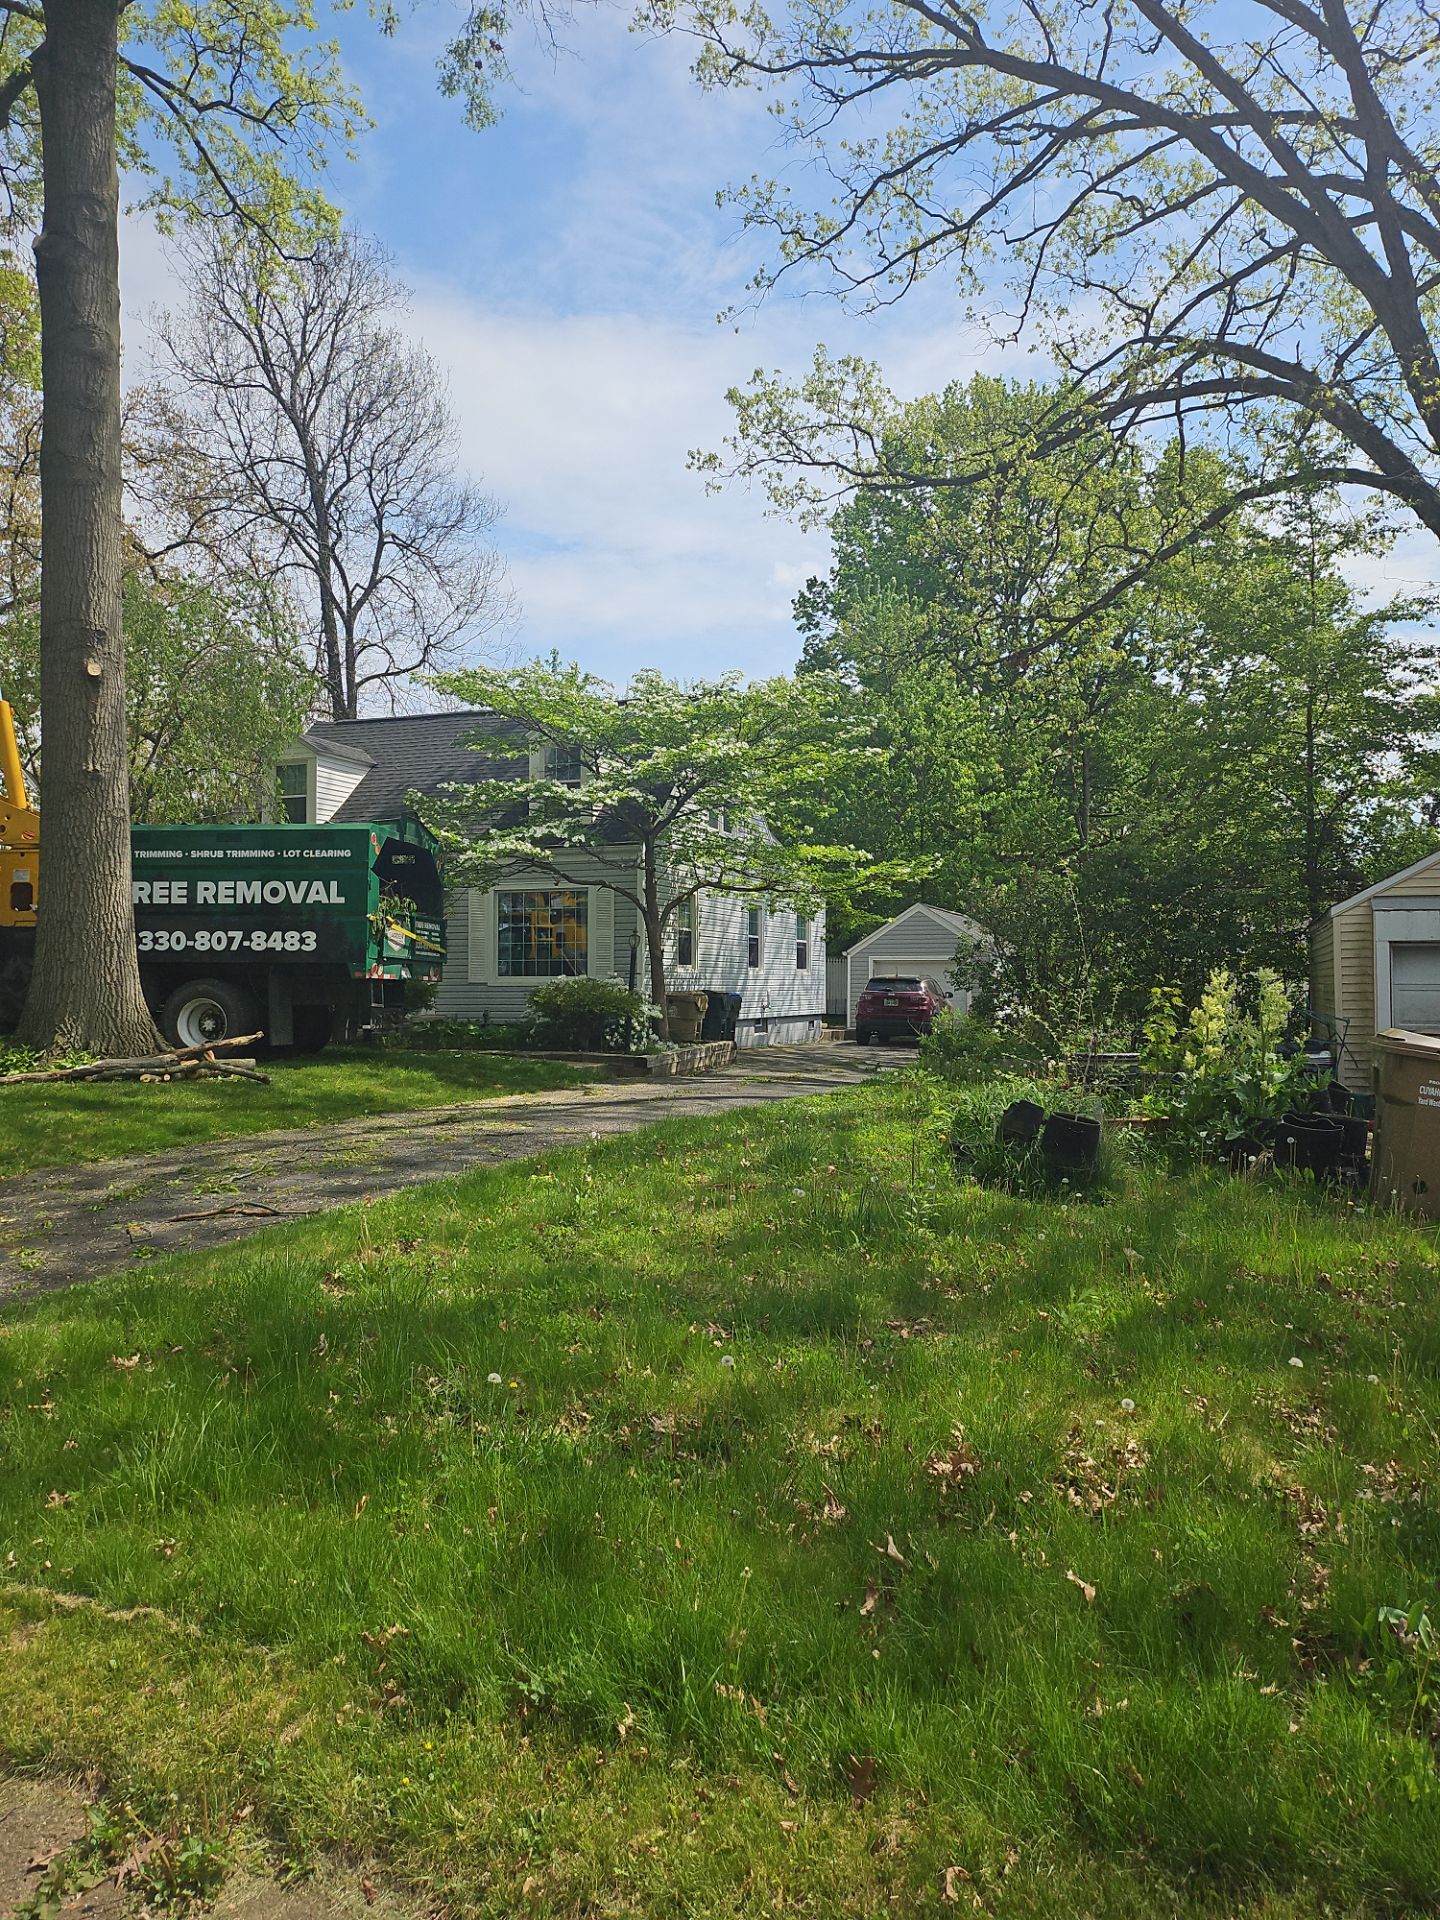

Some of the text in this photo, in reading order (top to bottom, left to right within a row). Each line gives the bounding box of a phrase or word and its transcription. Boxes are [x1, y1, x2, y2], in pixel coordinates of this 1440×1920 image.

[134, 850, 351, 858] TRIMMING SHRUB TRIMMING LOT CLEARING
[132, 881, 345, 904] REE REMOVAL
[138, 930, 317, 951] 330-807-8483
